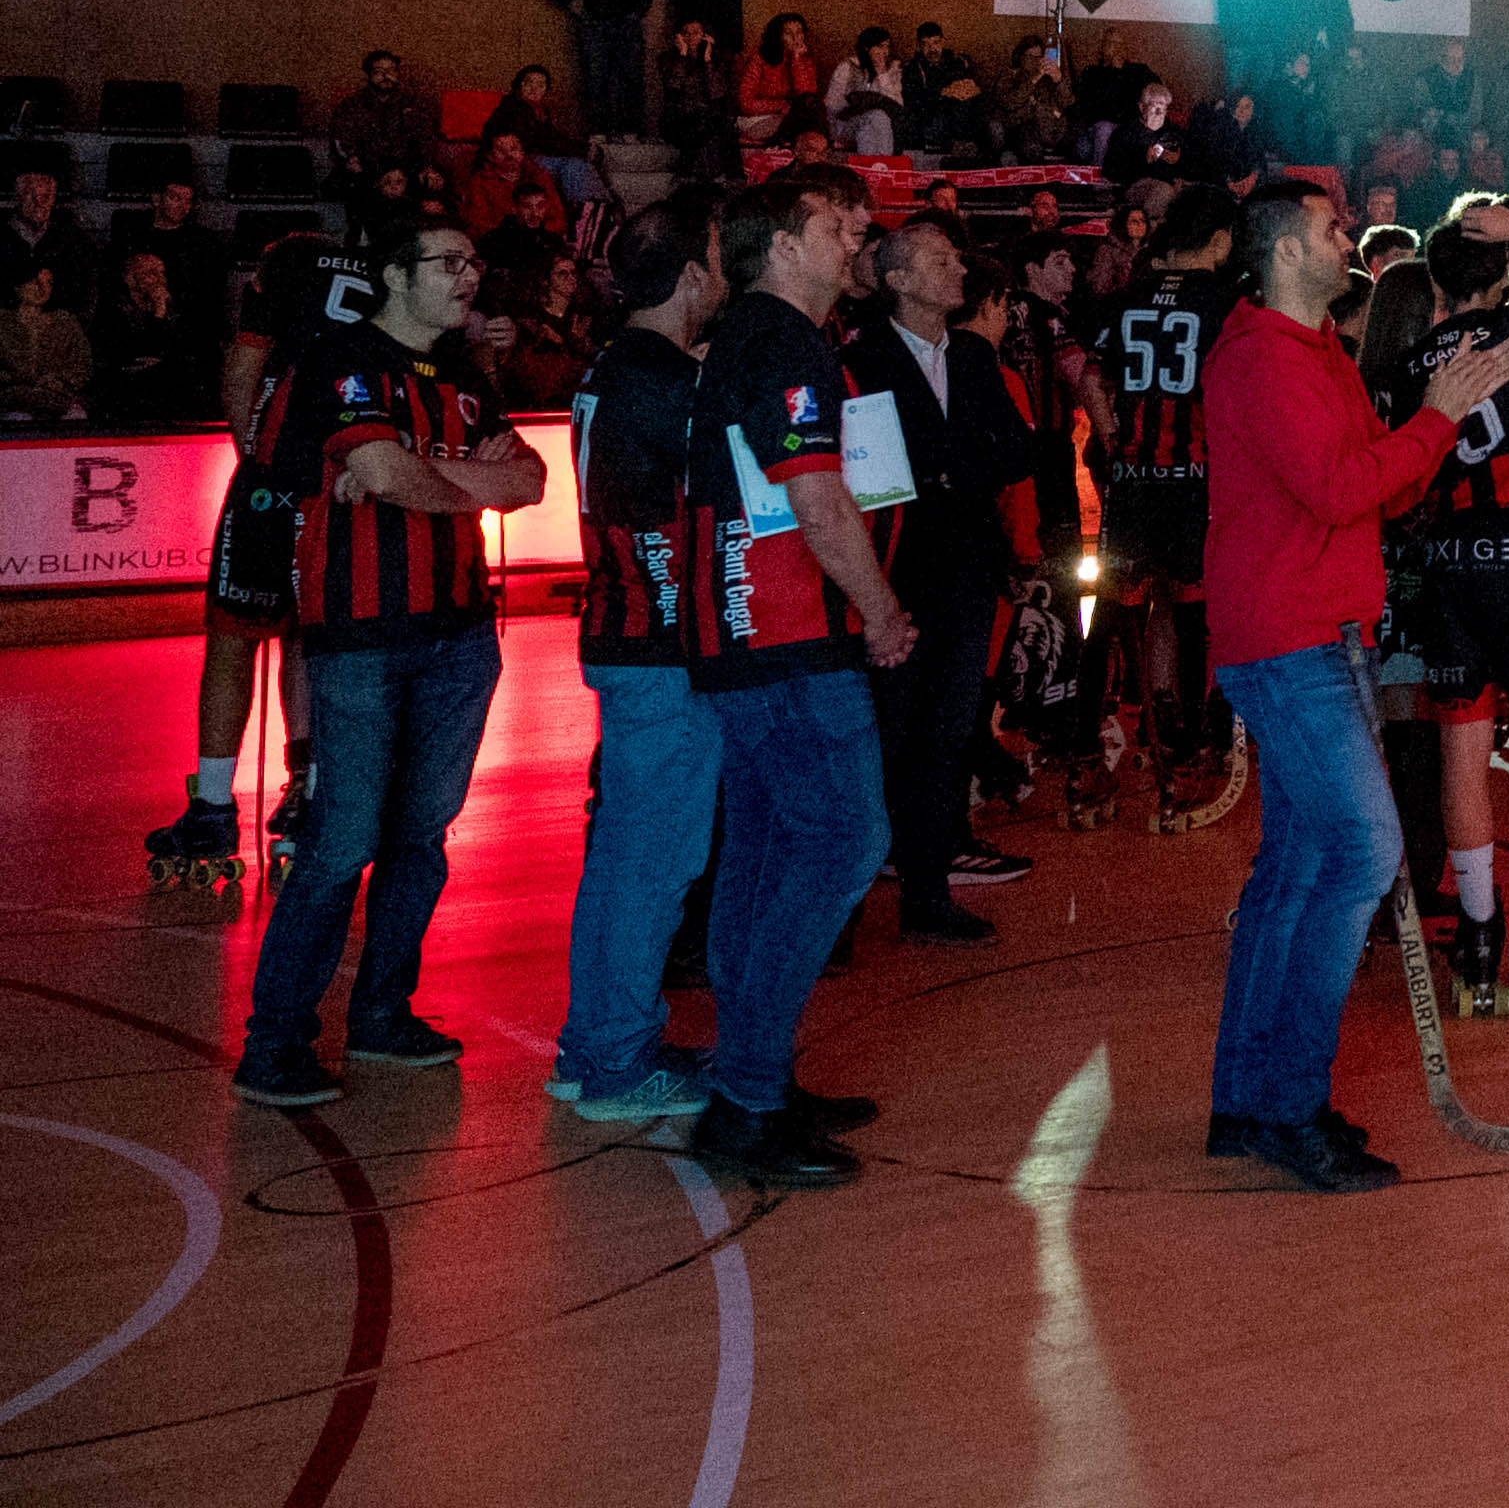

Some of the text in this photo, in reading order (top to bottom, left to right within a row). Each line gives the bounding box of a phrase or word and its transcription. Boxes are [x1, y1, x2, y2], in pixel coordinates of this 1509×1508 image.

[1120, 308, 1201, 395] 53
[71, 457, 138, 534] B
[724, 537, 753, 584] Sant
[723, 585, 759, 641] Cugat
